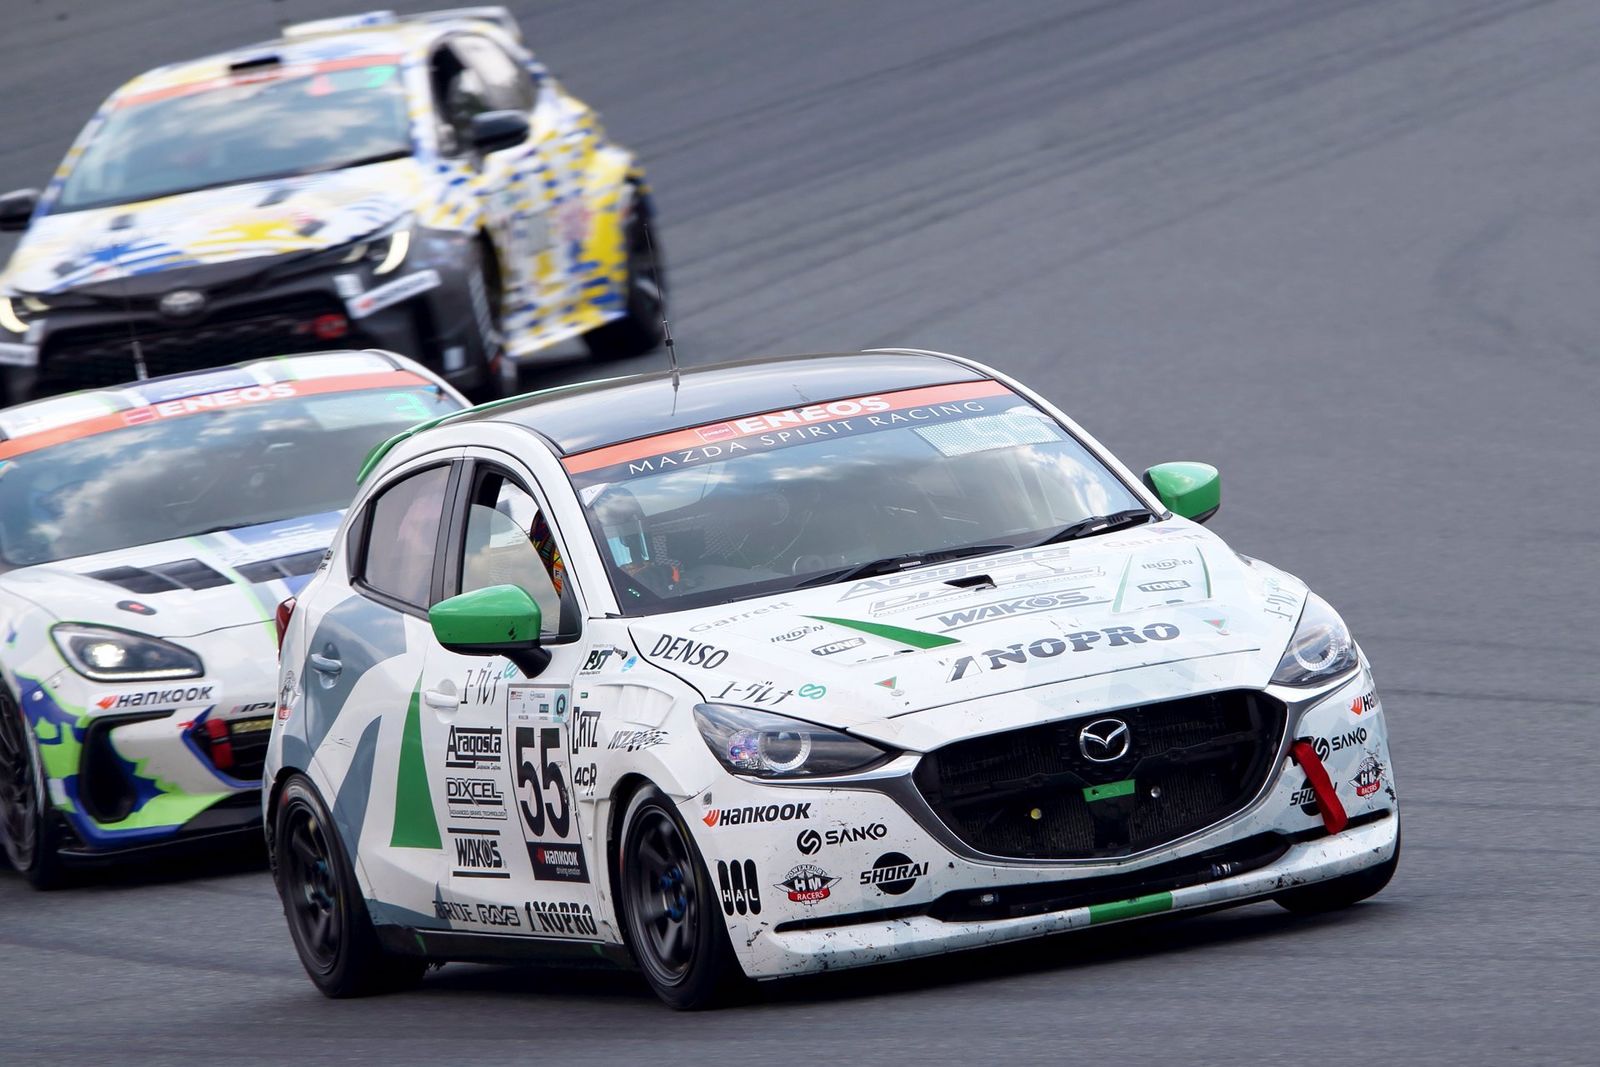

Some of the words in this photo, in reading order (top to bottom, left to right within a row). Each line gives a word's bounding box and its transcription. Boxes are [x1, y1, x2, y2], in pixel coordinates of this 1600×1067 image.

[156, 384, 297, 417] ENEOS
[735, 396, 891, 434] ENEOS
[628, 441, 748, 476] MAZDA
[760, 418, 855, 446] SPIRIT
[868, 400, 985, 428] RACING
[1141, 559, 1194, 571] IBIDEN
[1141, 580, 1188, 592] TONE
[688, 601, 796, 633] Garrett
[770, 624, 824, 643] IBIDEN
[650, 634, 729, 670] DENSO
[816, 637, 863, 656] TONE
[582, 650, 614, 670] BST
[446, 725, 502, 768] Aragosta
[1331, 727, 1367, 751] SANKO
[515, 727, 570, 838] 55
[575, 763, 597, 786] 4CR
[447, 781, 502, 800] DIXCEL
[825, 823, 888, 847] SANKO
[794, 877, 822, 892] HM
[859, 861, 929, 886] SHORAI
[722, 888, 758, 902] HAL
[797, 891, 824, 900] RACERS
[476, 904, 521, 926] RAYS
